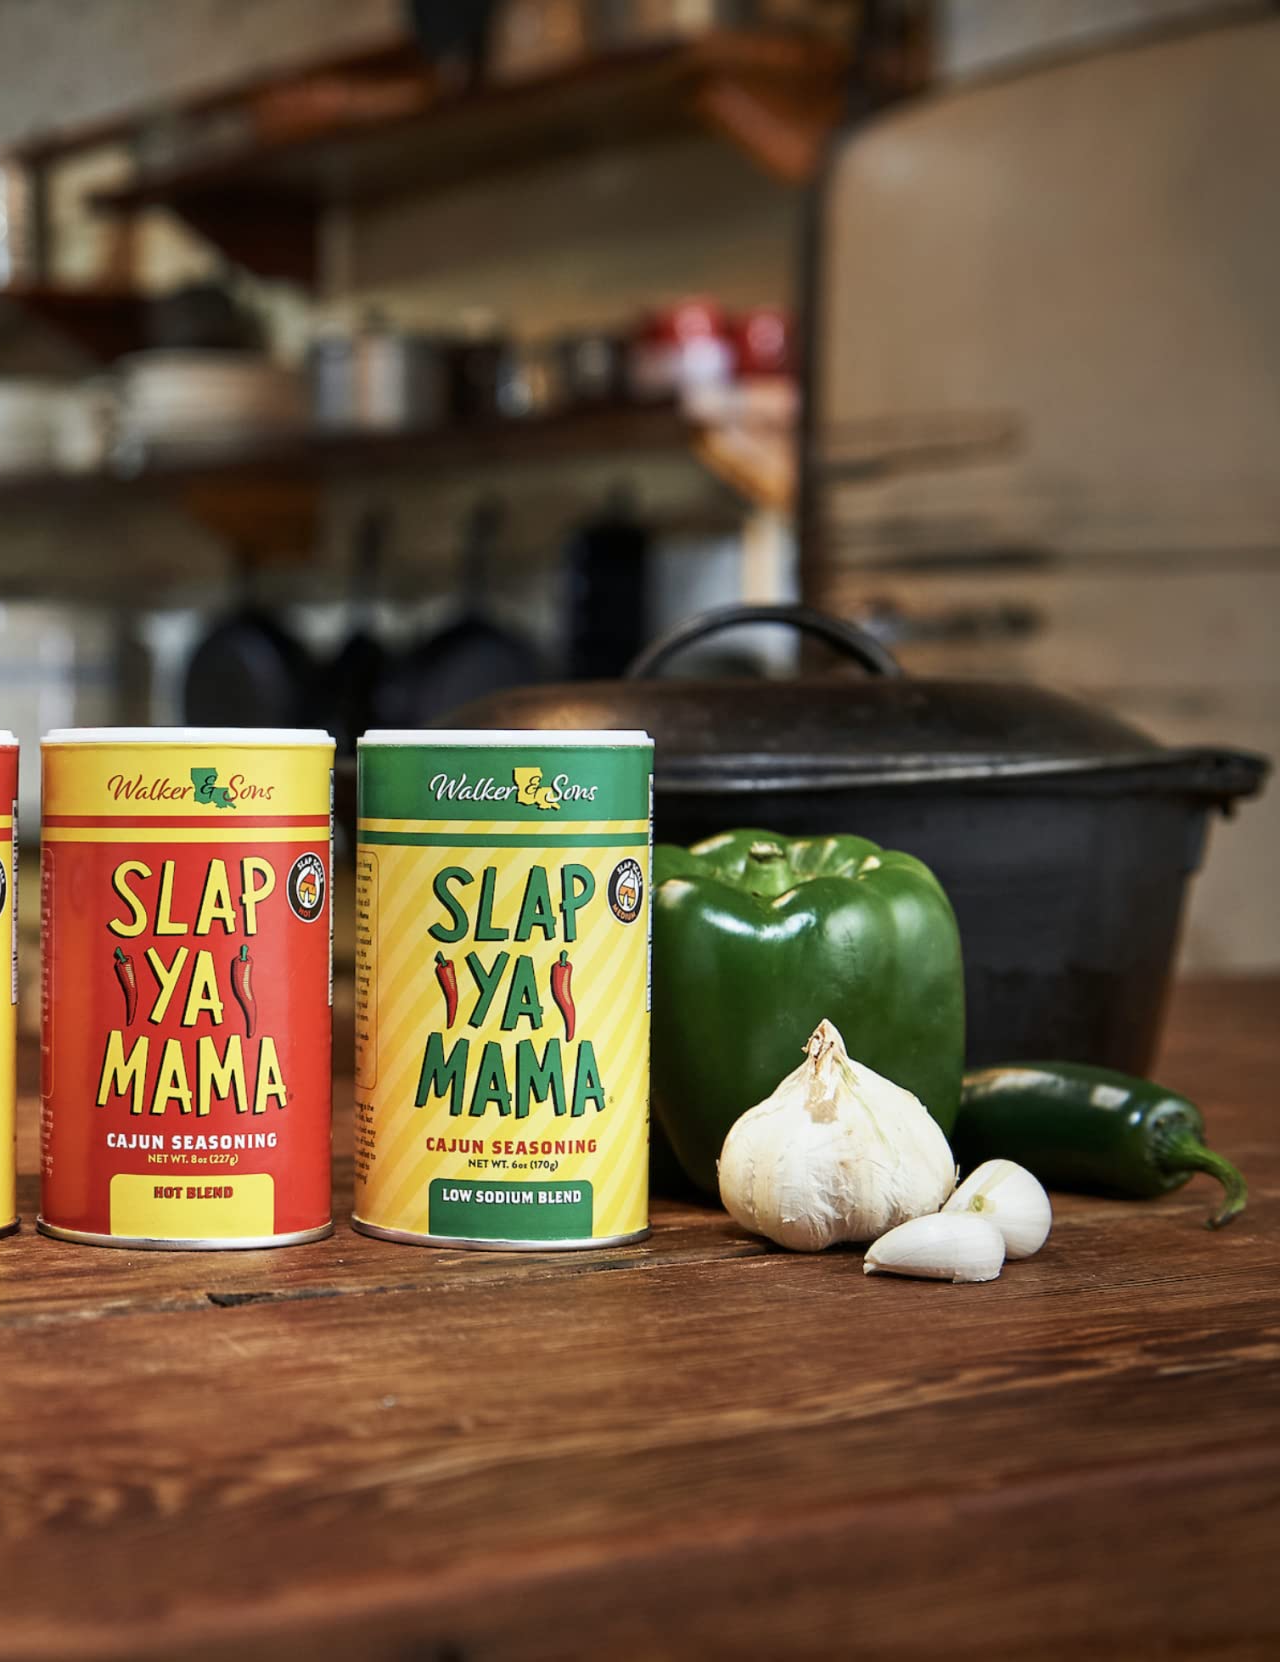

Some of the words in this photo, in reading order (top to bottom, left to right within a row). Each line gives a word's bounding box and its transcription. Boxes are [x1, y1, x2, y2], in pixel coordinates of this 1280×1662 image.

[107, 774, 193, 801] Walker
[200, 775, 217, 798] &
[222, 774, 275, 801] Sons
[429, 773, 518, 801] Walker
[525, 776, 541, 798] &
[545, 774, 599, 802] Sons
[106, 856, 276, 938] SLAP
[427, 863, 596, 943] SLAP
[144, 946, 224, 1027] YA
[465, 950, 544, 1031] YA
[96, 1030, 288, 1117] MAMA
[414, 1032, 606, 1119] MAMA
[107, 1133, 164, 1150] CAJUN
[171, 1132, 277, 1150] SEASONING
[426, 1137, 484, 1154] CAJUN
[492, 1139, 597, 1155] SEASONING
[148, 1154, 168, 1164] NET
[171, 1154, 189, 1164] WT.
[209, 1154, 239, 1166] (227g)
[468, 1159, 488, 1169] NET
[491, 1159, 509, 1169] WT.
[530, 1159, 559, 1172] (170g)
[154, 1186, 183, 1199] HOT
[186, 1186, 233, 1200] BLEND
[442, 1188, 472, 1203] LOW
[475, 1190, 534, 1204] SODIUM
[538, 1190, 582, 1204] BLEND
